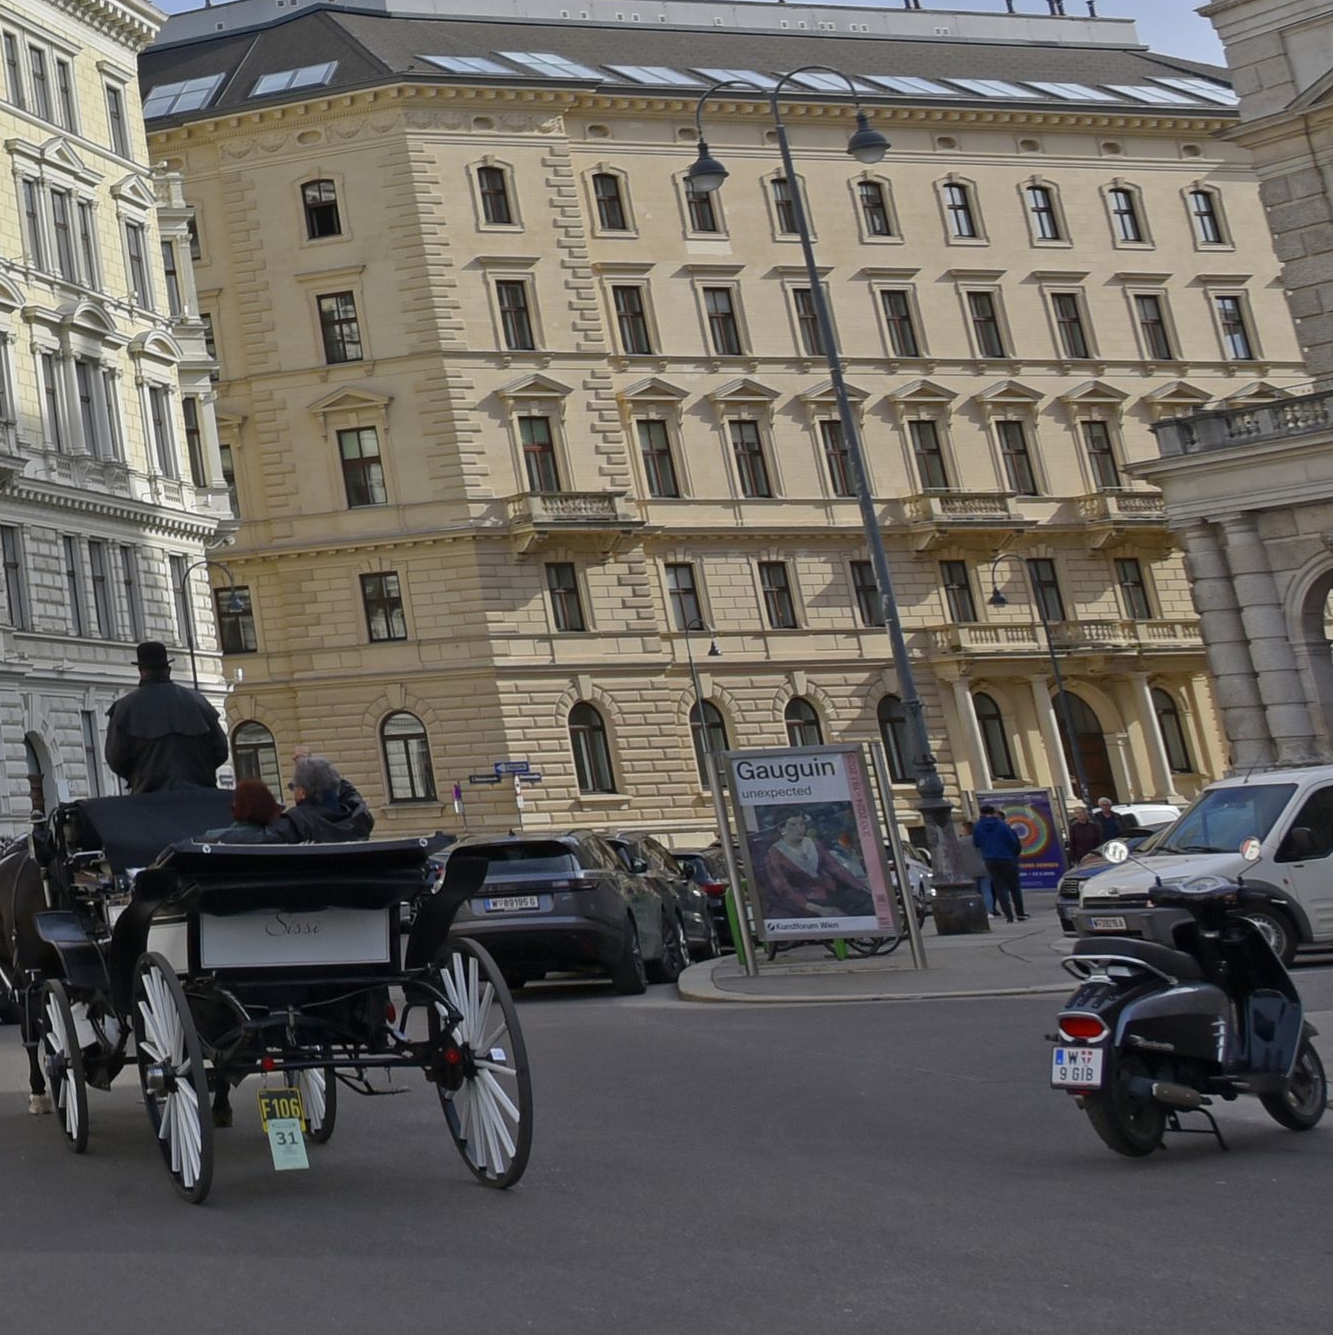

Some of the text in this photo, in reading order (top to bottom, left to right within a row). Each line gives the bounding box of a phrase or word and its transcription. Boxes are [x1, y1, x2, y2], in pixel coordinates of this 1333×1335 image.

[737, 757, 836, 782] Gauguin
[741, 785, 812, 800] unexpected
[265, 911, 321, 937] Sissi
[776, 921, 840, 931] Kunstforum Wien
[1068, 1051, 1079, 1065] W
[1059, 1067, 1093, 1081] 9 GIB
[276, 1132, 298, 1145] 31
